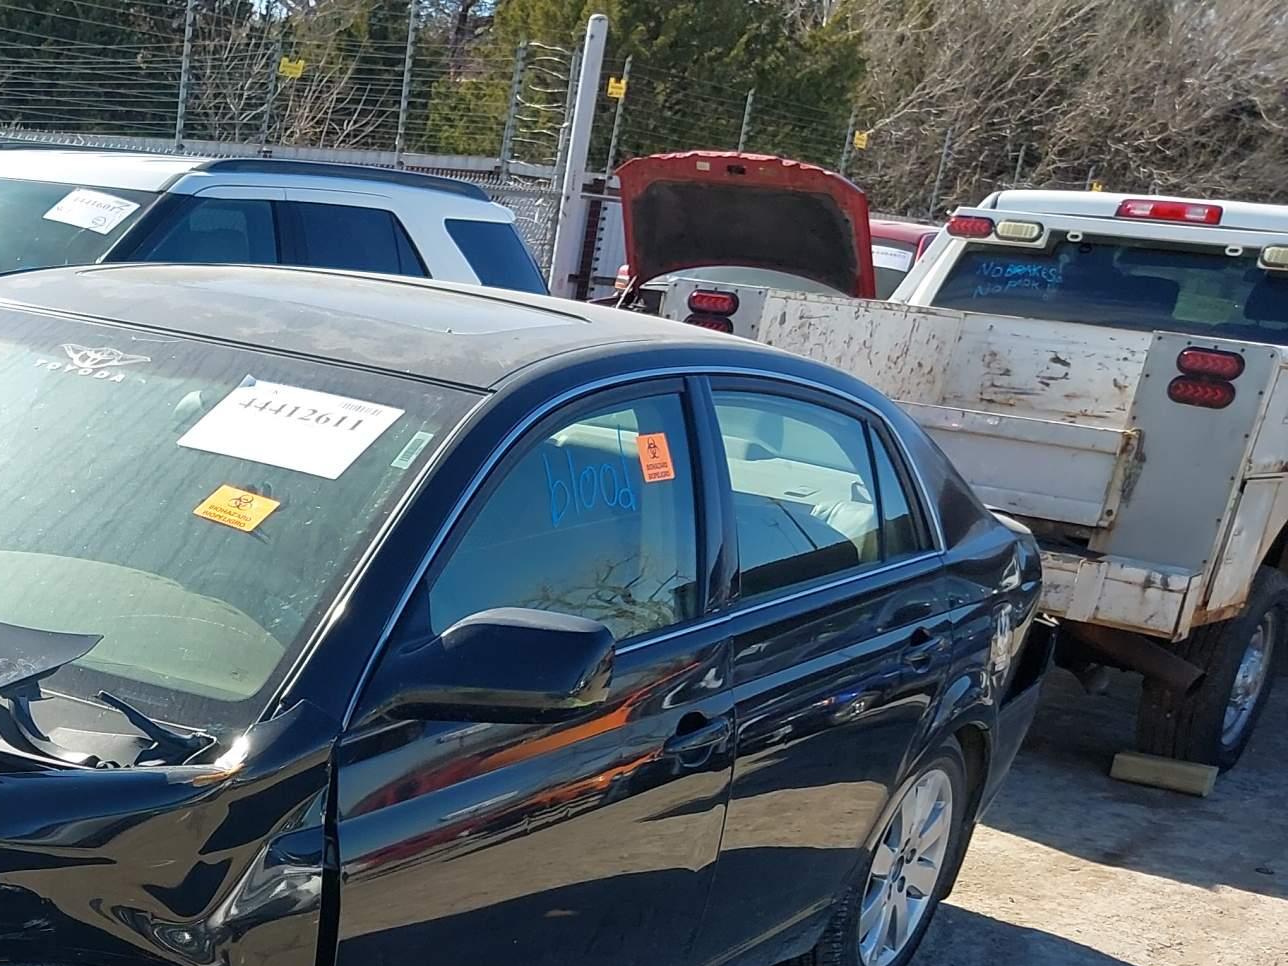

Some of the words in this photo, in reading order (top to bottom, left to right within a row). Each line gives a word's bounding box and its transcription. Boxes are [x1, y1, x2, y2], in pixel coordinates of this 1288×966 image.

[239, 398, 364, 431] 44412611
[542, 424, 636, 528] blood
[208, 504, 252, 522] BIOHAZARD
